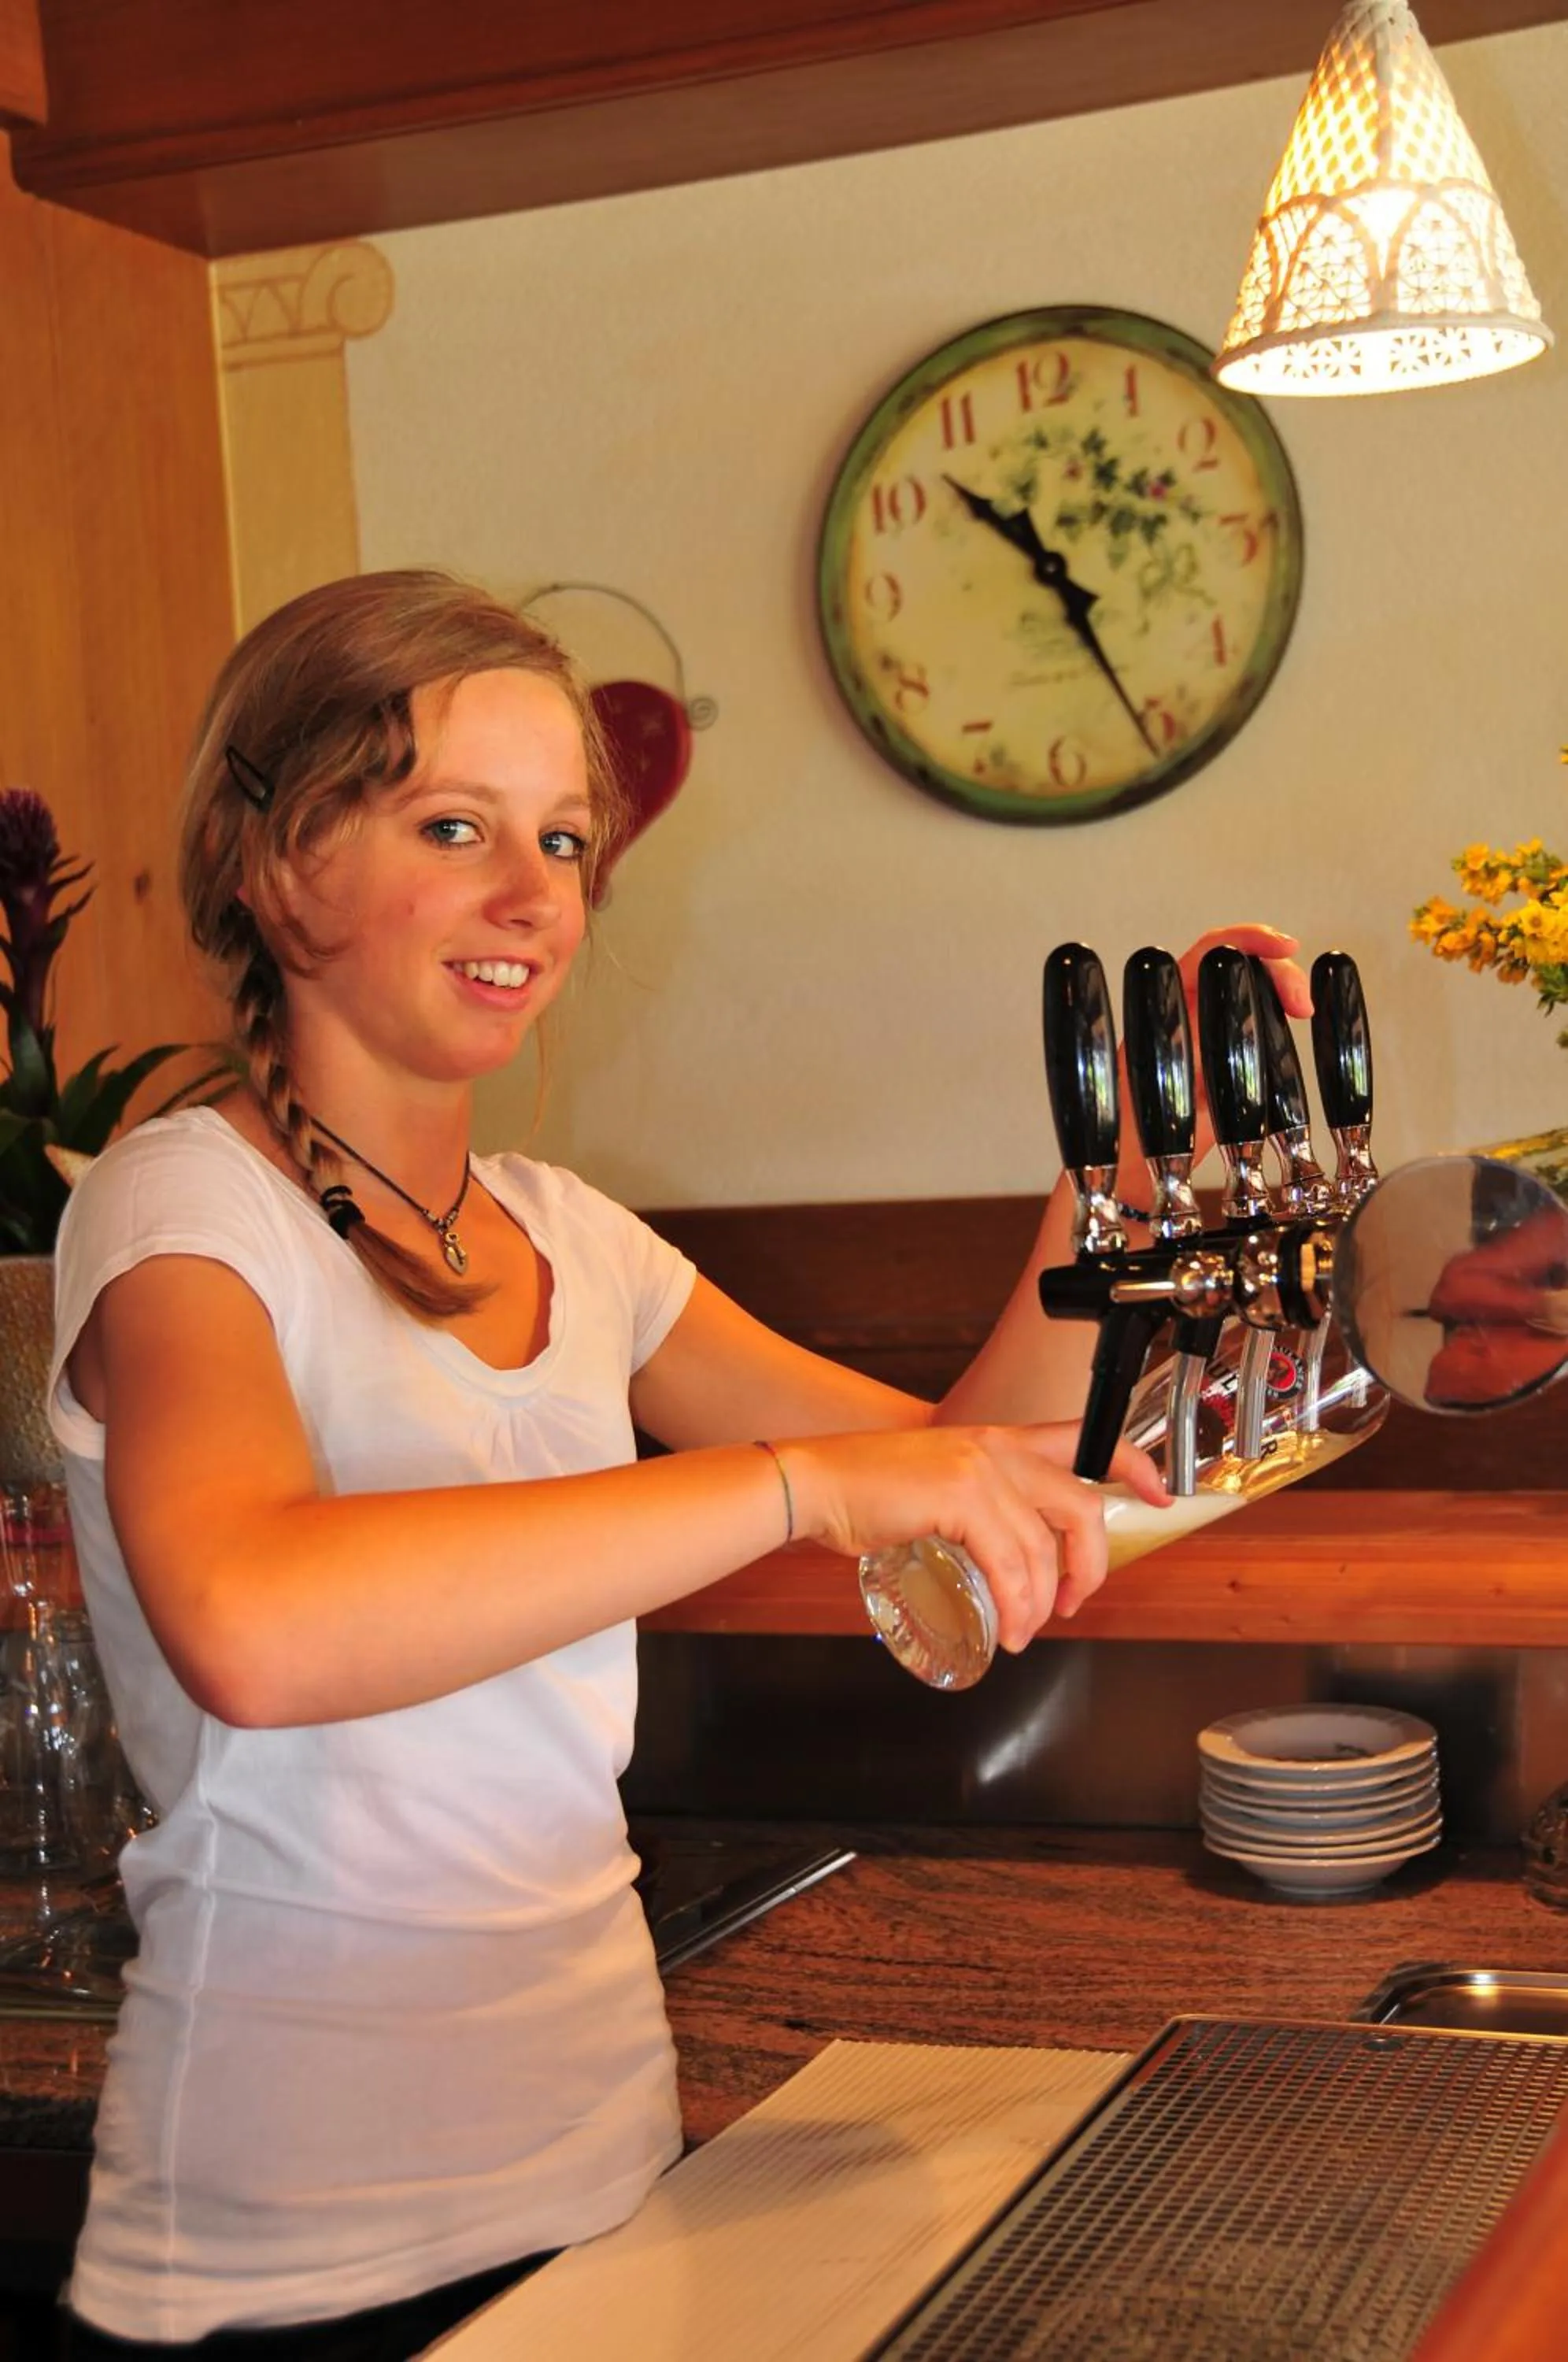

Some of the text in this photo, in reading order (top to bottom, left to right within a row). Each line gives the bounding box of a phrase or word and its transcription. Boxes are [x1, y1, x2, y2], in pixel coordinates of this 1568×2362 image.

[1015, 351, 1071, 413] 12
[1123, 362, 1142, 418] 1
[939, 390, 977, 451] 11
[1178, 416, 1219, 471] 2
[870, 477, 926, 535] 10
[864, 572, 903, 624] 9
[894, 663, 930, 712] 8
[1048, 734, 1087, 788] 6
